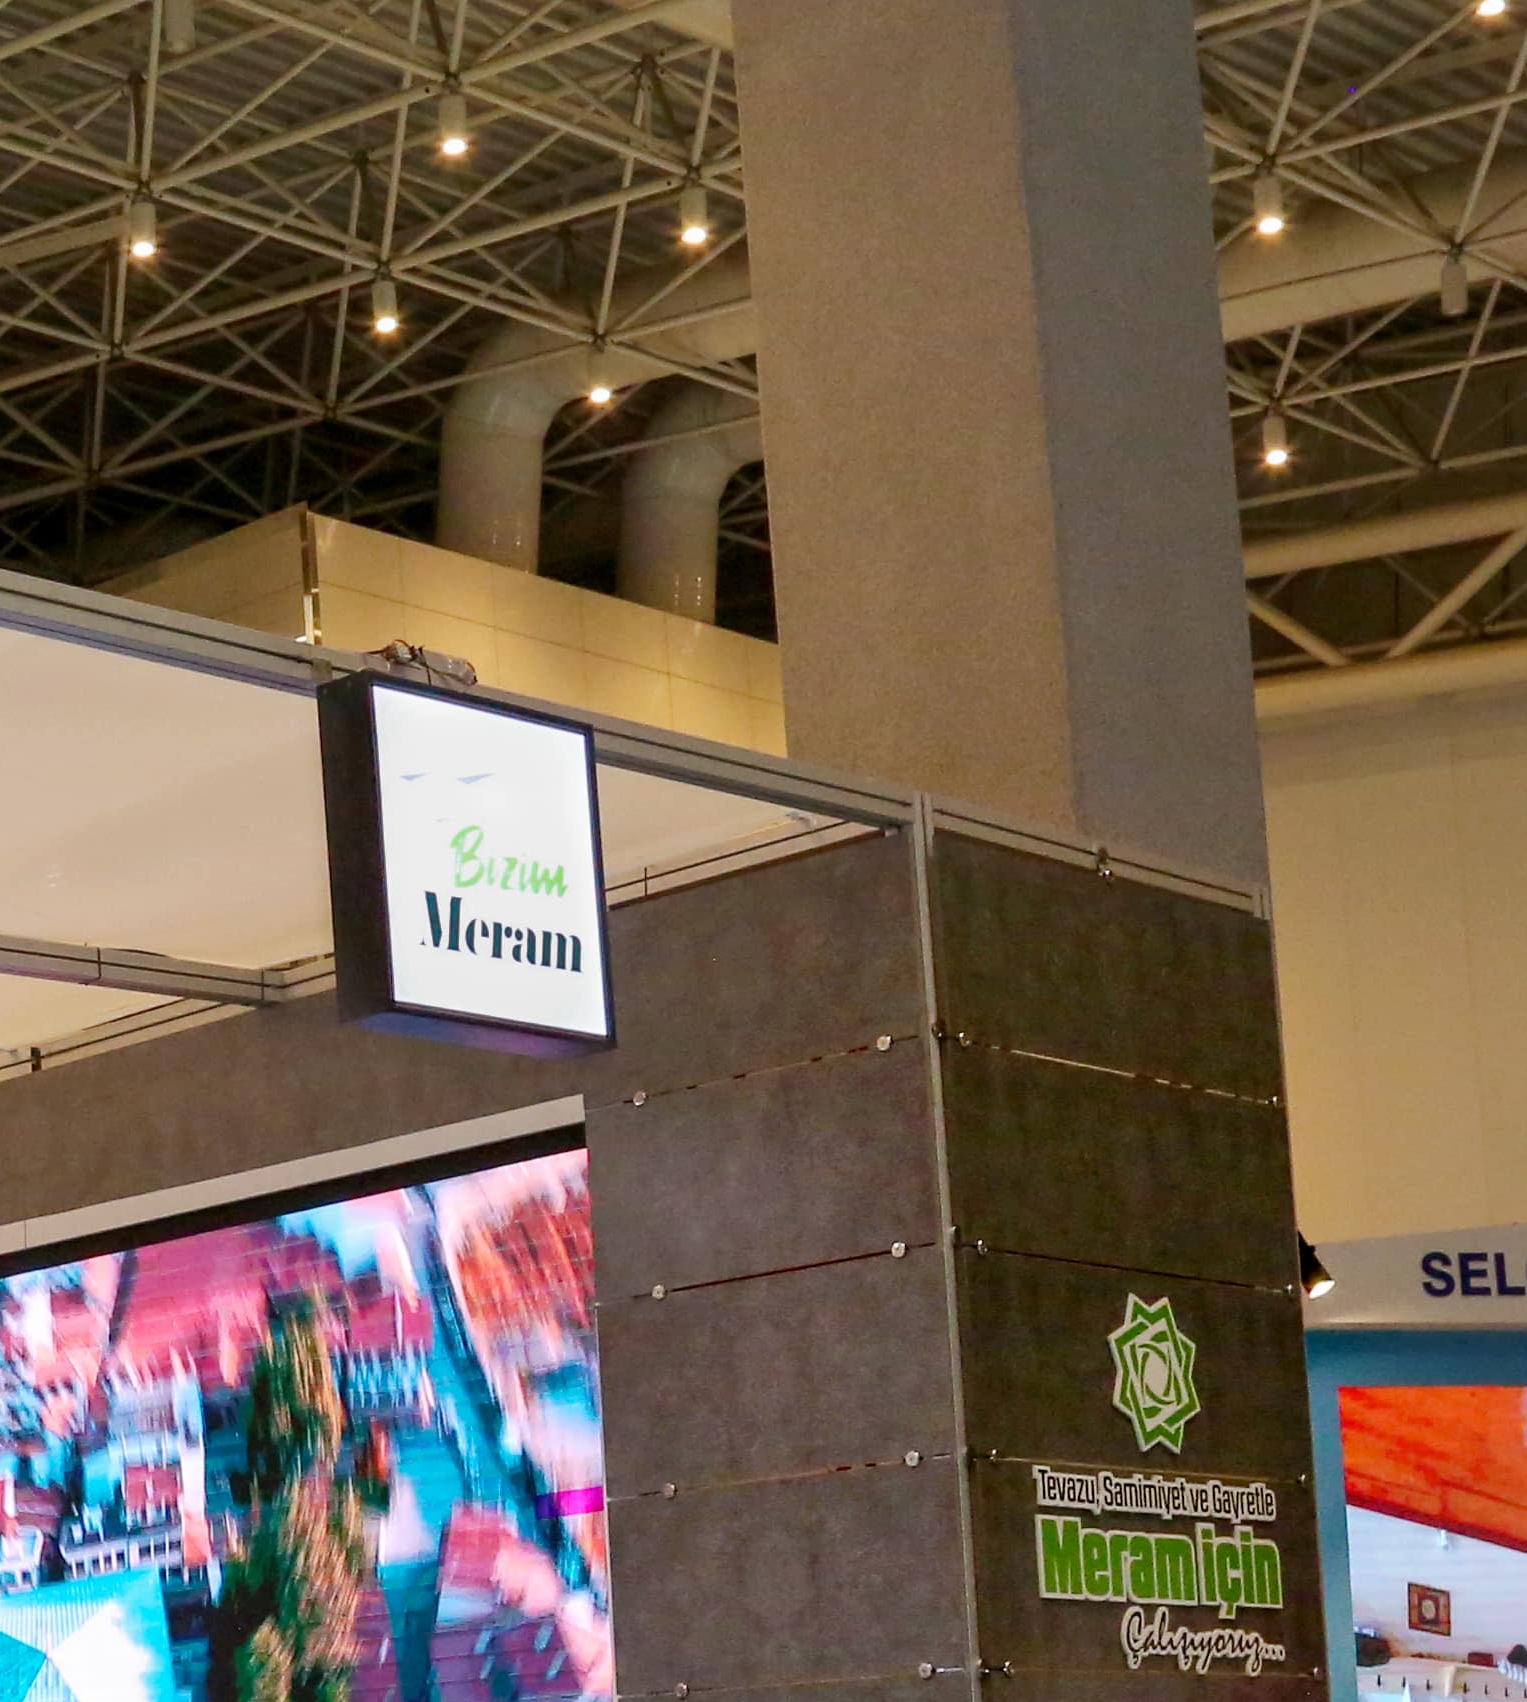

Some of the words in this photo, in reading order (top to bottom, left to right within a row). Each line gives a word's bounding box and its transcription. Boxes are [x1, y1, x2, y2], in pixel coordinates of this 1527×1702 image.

[450, 824, 569, 898] Bizim
[419, 890, 584, 973] Meram
[1422, 1252, 1527, 1297] SEL
[1038, 1469, 1100, 1507] Tevazu,
[1103, 1475, 1187, 1515] Samimiyet
[1189, 1488, 1209, 1513] ve
[1211, 1484, 1275, 1519] Gayretle
[1040, 1518, 1196, 1602] Meram
[1199, 1527, 1281, 1617] için
